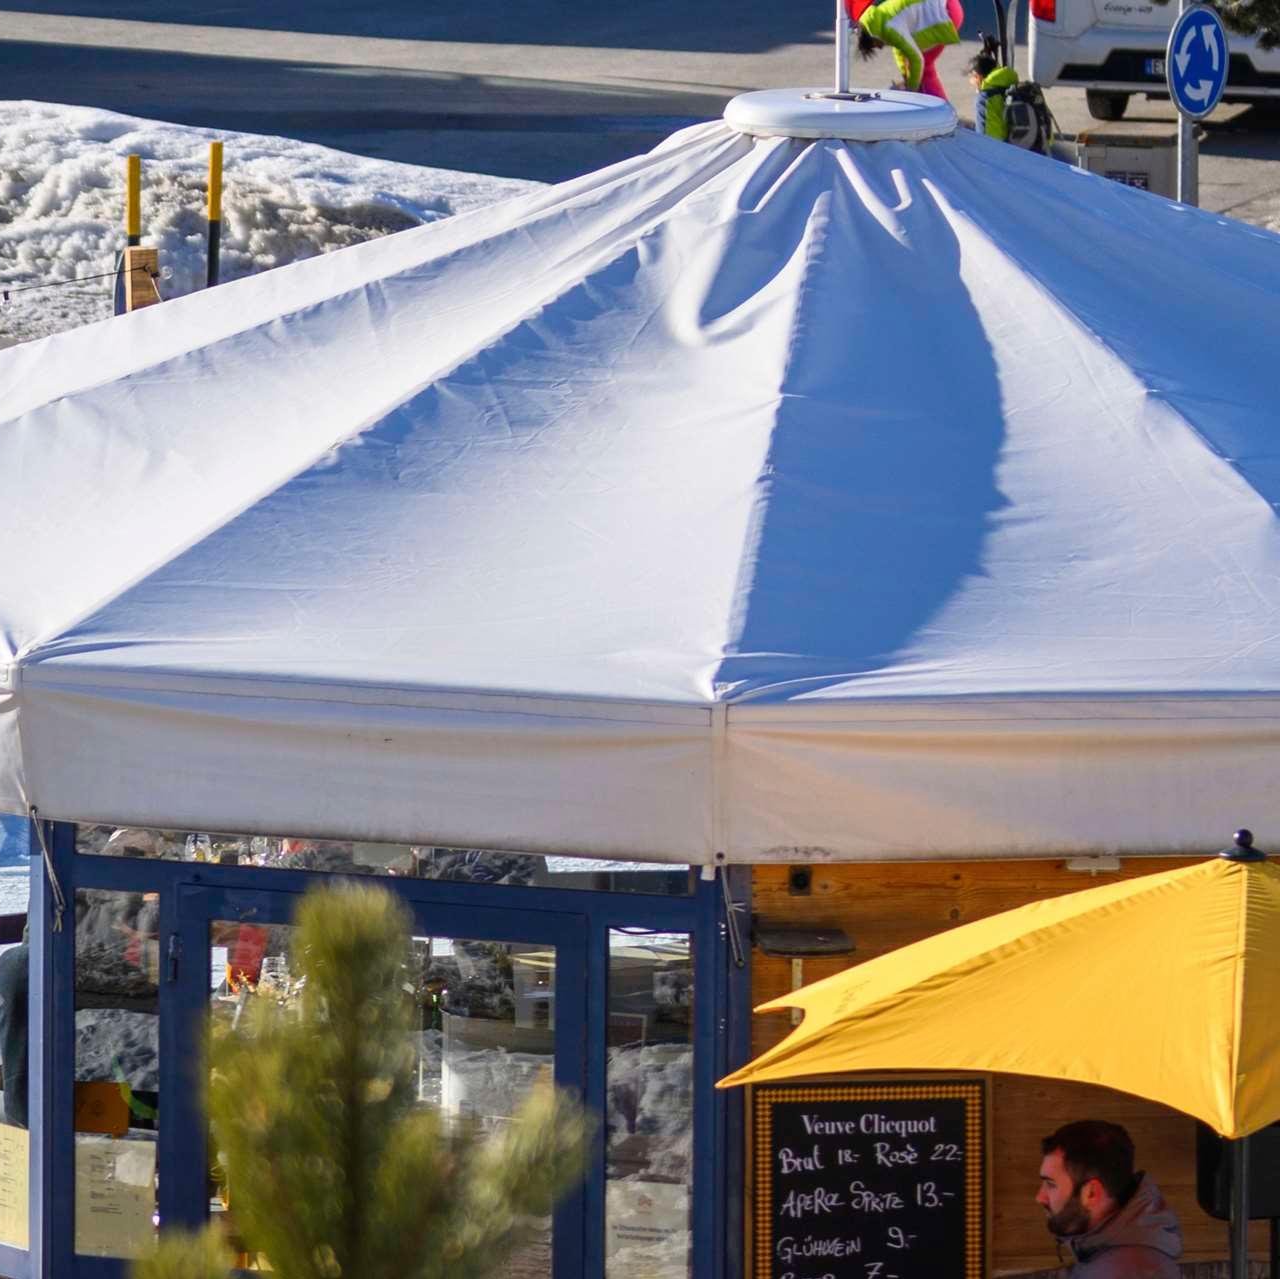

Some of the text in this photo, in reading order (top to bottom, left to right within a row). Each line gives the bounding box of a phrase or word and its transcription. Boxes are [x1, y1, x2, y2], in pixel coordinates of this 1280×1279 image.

[800, 1113, 937, 1138] Veuve Clicquot
[778, 1144, 825, 1174] Brut
